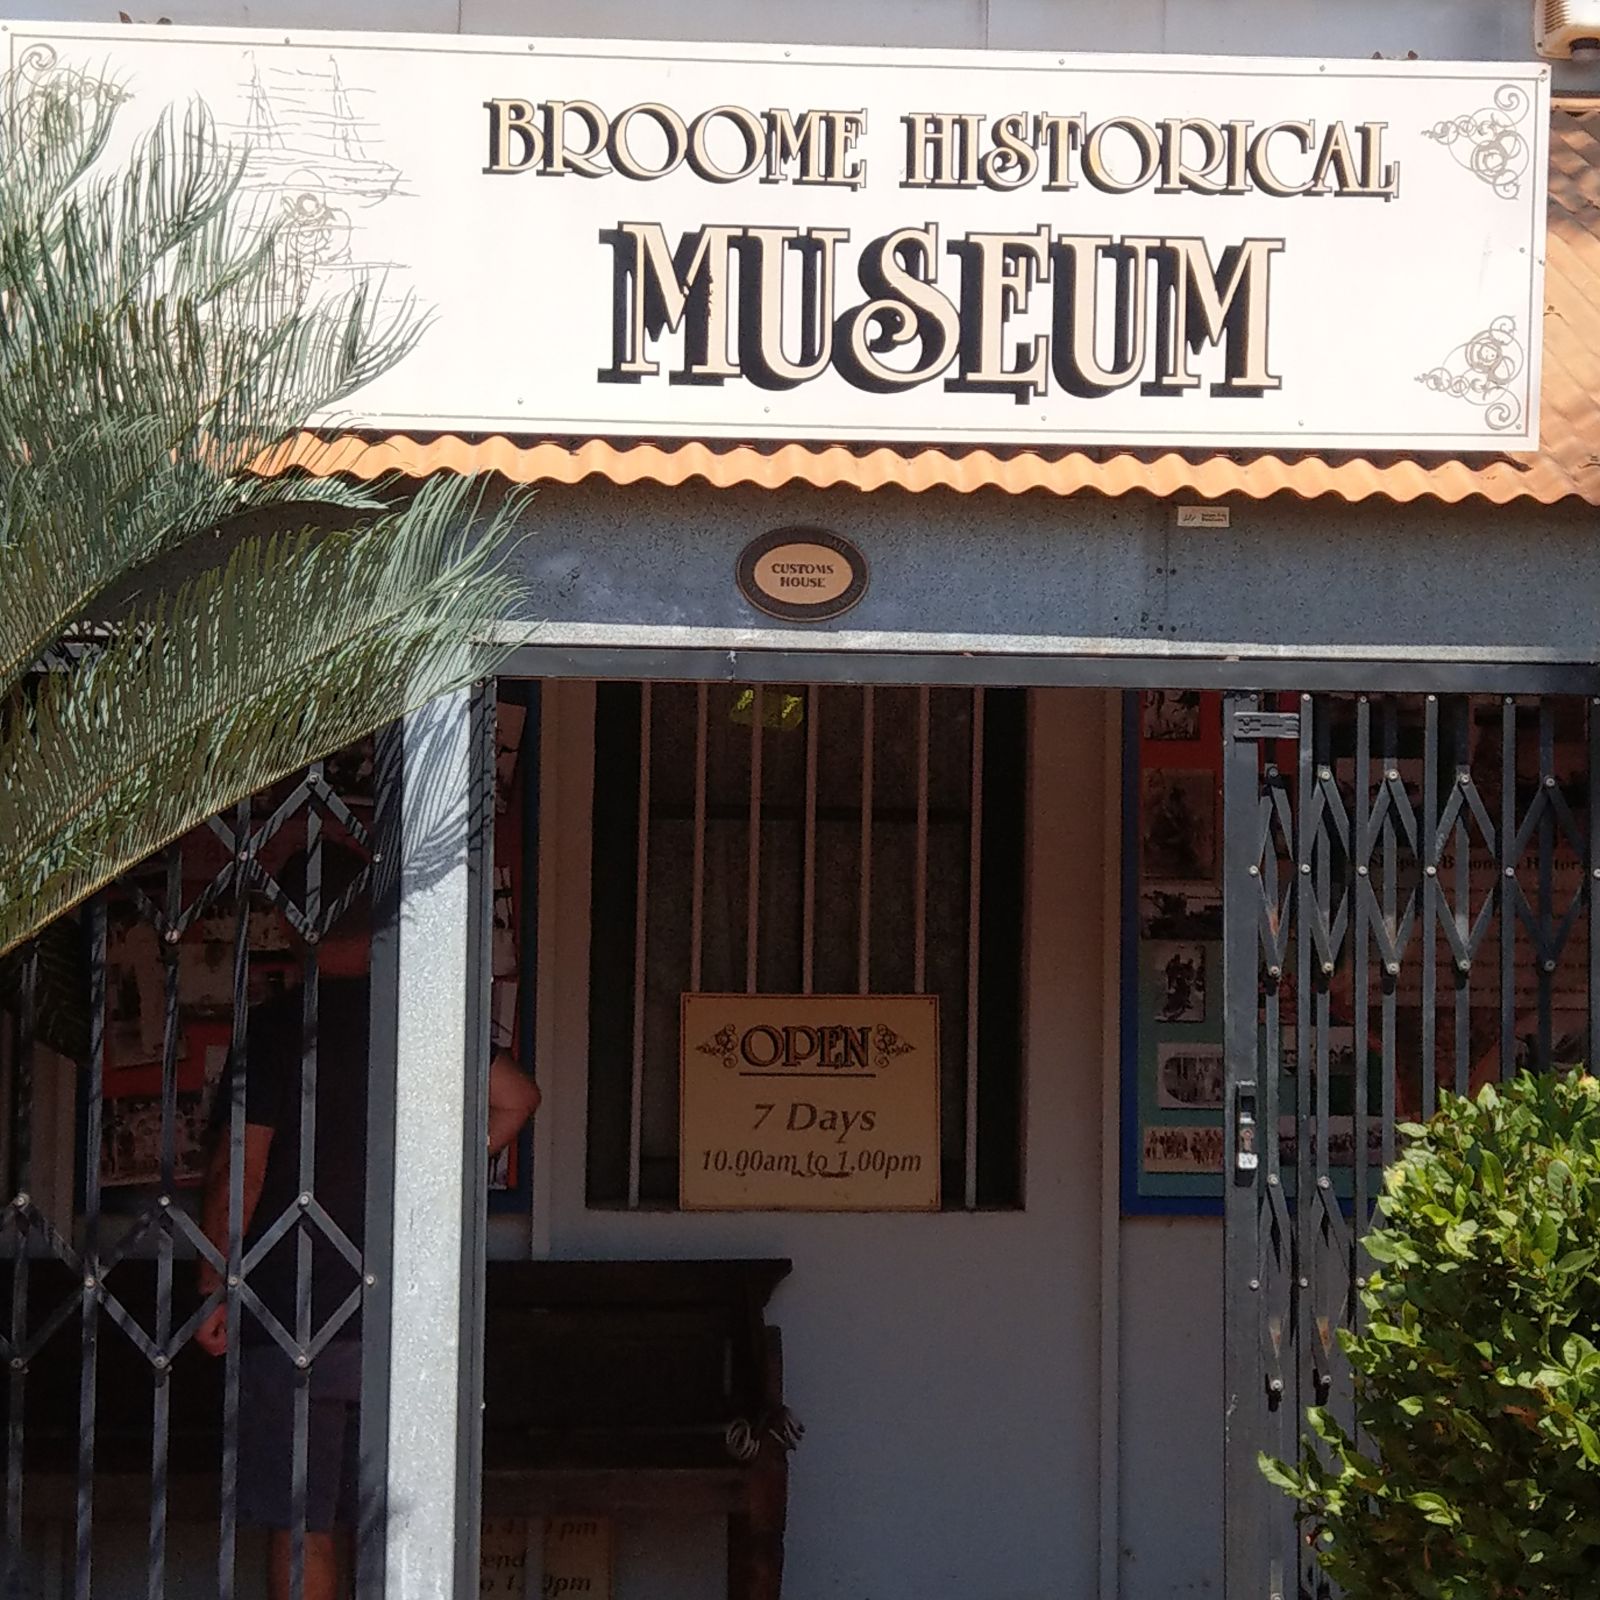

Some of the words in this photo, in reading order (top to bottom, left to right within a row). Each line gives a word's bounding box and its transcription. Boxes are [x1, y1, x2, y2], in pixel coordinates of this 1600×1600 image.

[483, 97, 869, 191] BROOME
[899, 110, 1401, 202] HISTORICAL
[598, 221, 1286, 405] MUSEUM
[771, 563, 834, 574] CUSTOMS
[780, 576, 826, 588] HOUSE
[740, 1025, 872, 1069] OPEN
[752, 1103, 775, 1131] 7
[786, 1103, 877, 1144] Days
[807, 1150, 829, 1173] to
